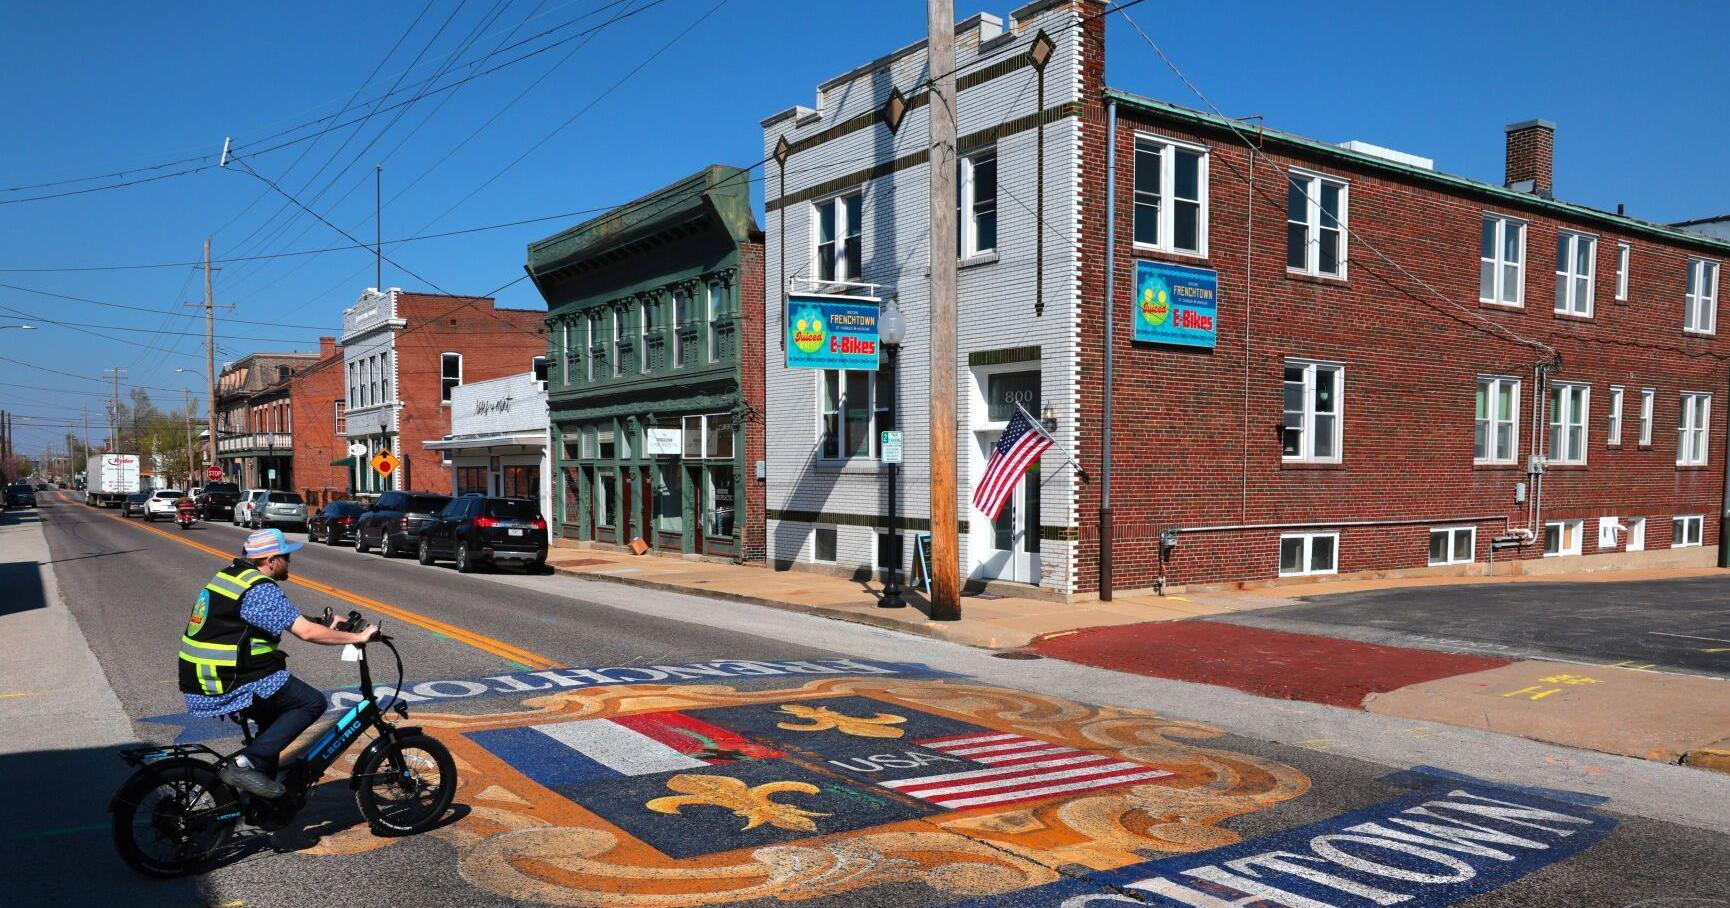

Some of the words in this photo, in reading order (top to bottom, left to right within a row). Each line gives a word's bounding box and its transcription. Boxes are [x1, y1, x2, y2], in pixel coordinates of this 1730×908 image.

[1173, 285, 1213, 299] FRENCHTOWN
[830, 314, 875, 327] FRENCHTOWN
[1173, 308, 1213, 331] E-Bikes
[794, 331, 823, 343] Juiced
[830, 336, 875, 354] E-Bikes
[1005, 390, 1033, 404] 800
[325, 659, 899, 713] FRENCHTOW
[322, 720, 362, 760] LECTRIC
[828, 751, 961, 773] USA
